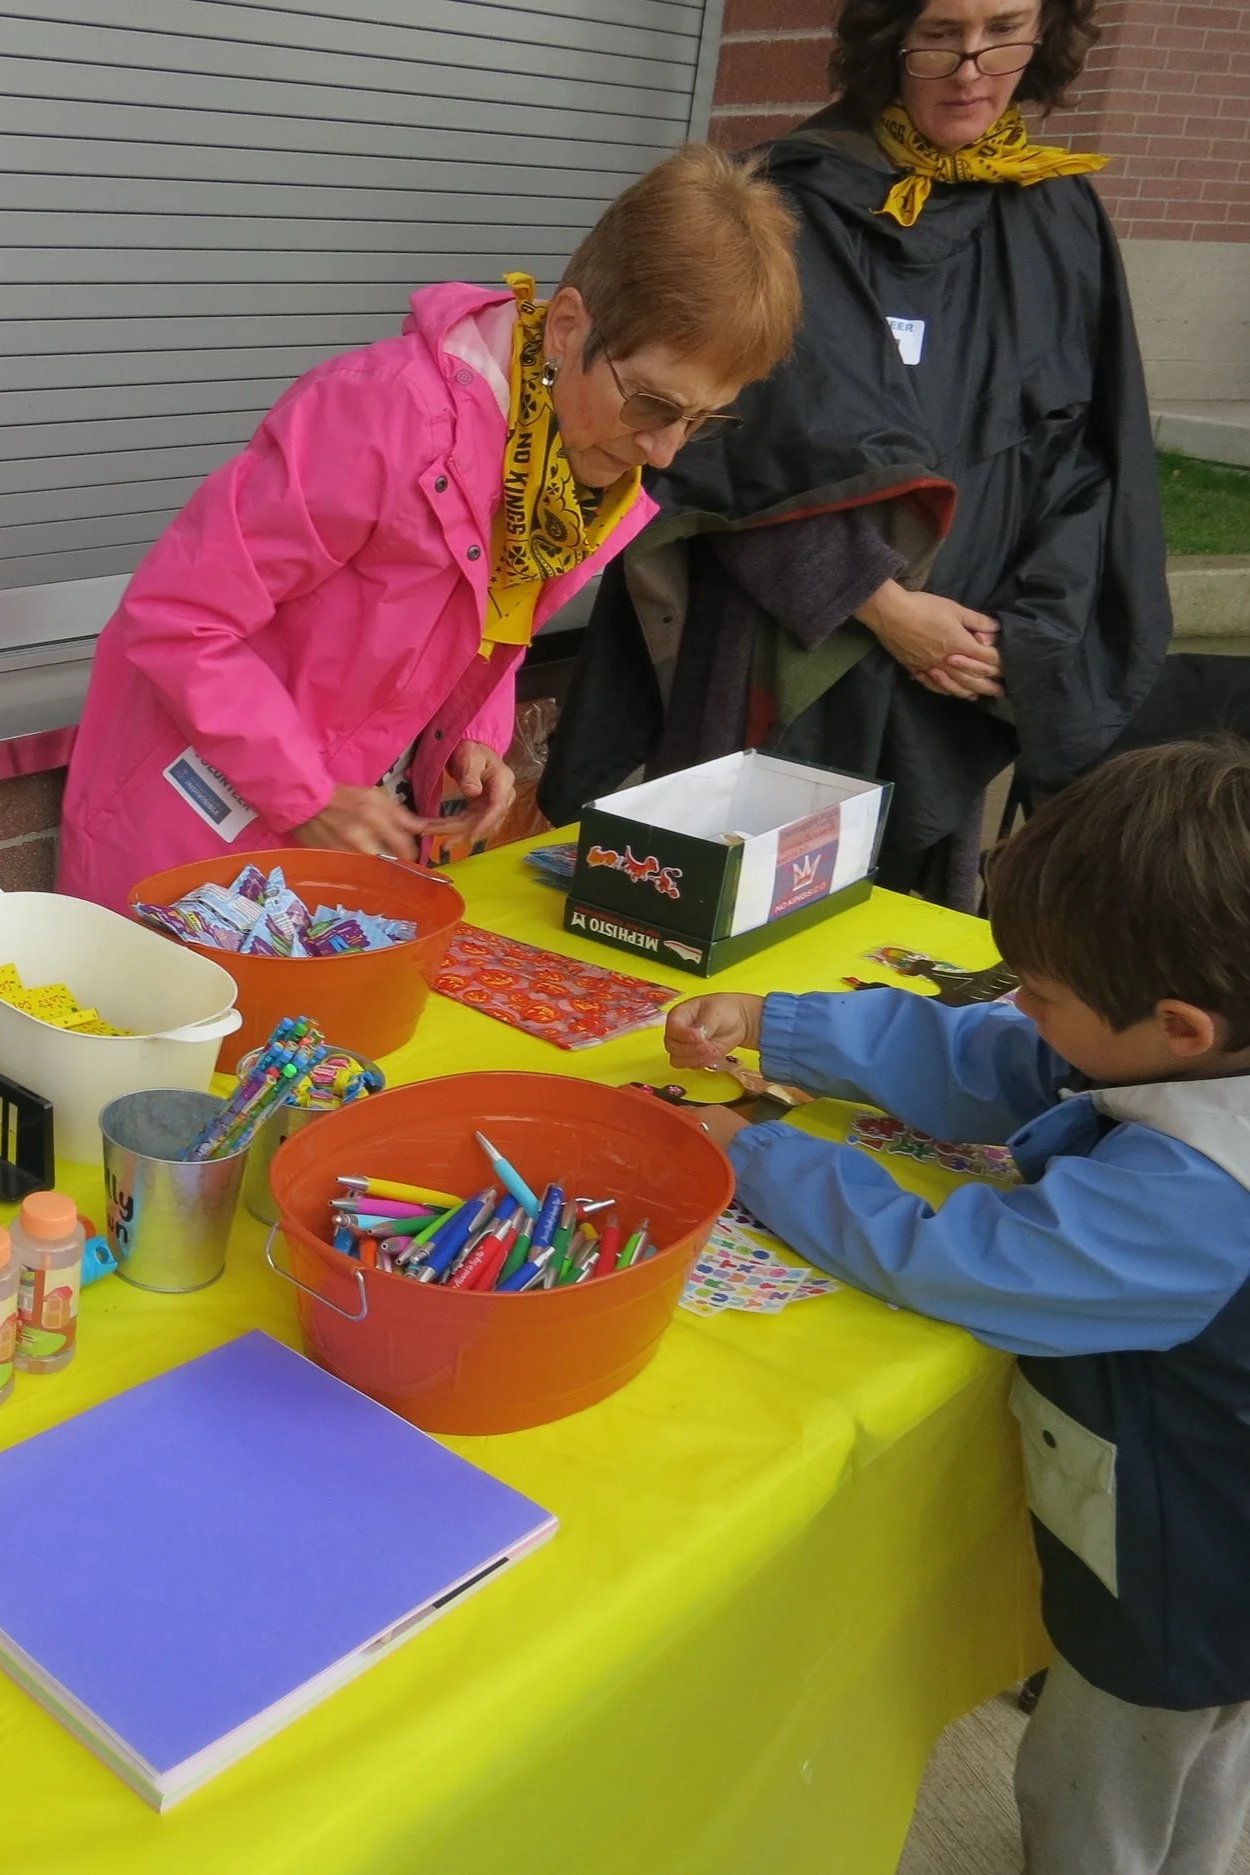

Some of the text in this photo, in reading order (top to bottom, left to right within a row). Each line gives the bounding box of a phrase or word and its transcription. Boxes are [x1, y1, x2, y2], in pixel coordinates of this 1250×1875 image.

[504, 432, 533, 535] NO KINGS
[589, 918, 659, 952] MEPHISTO
